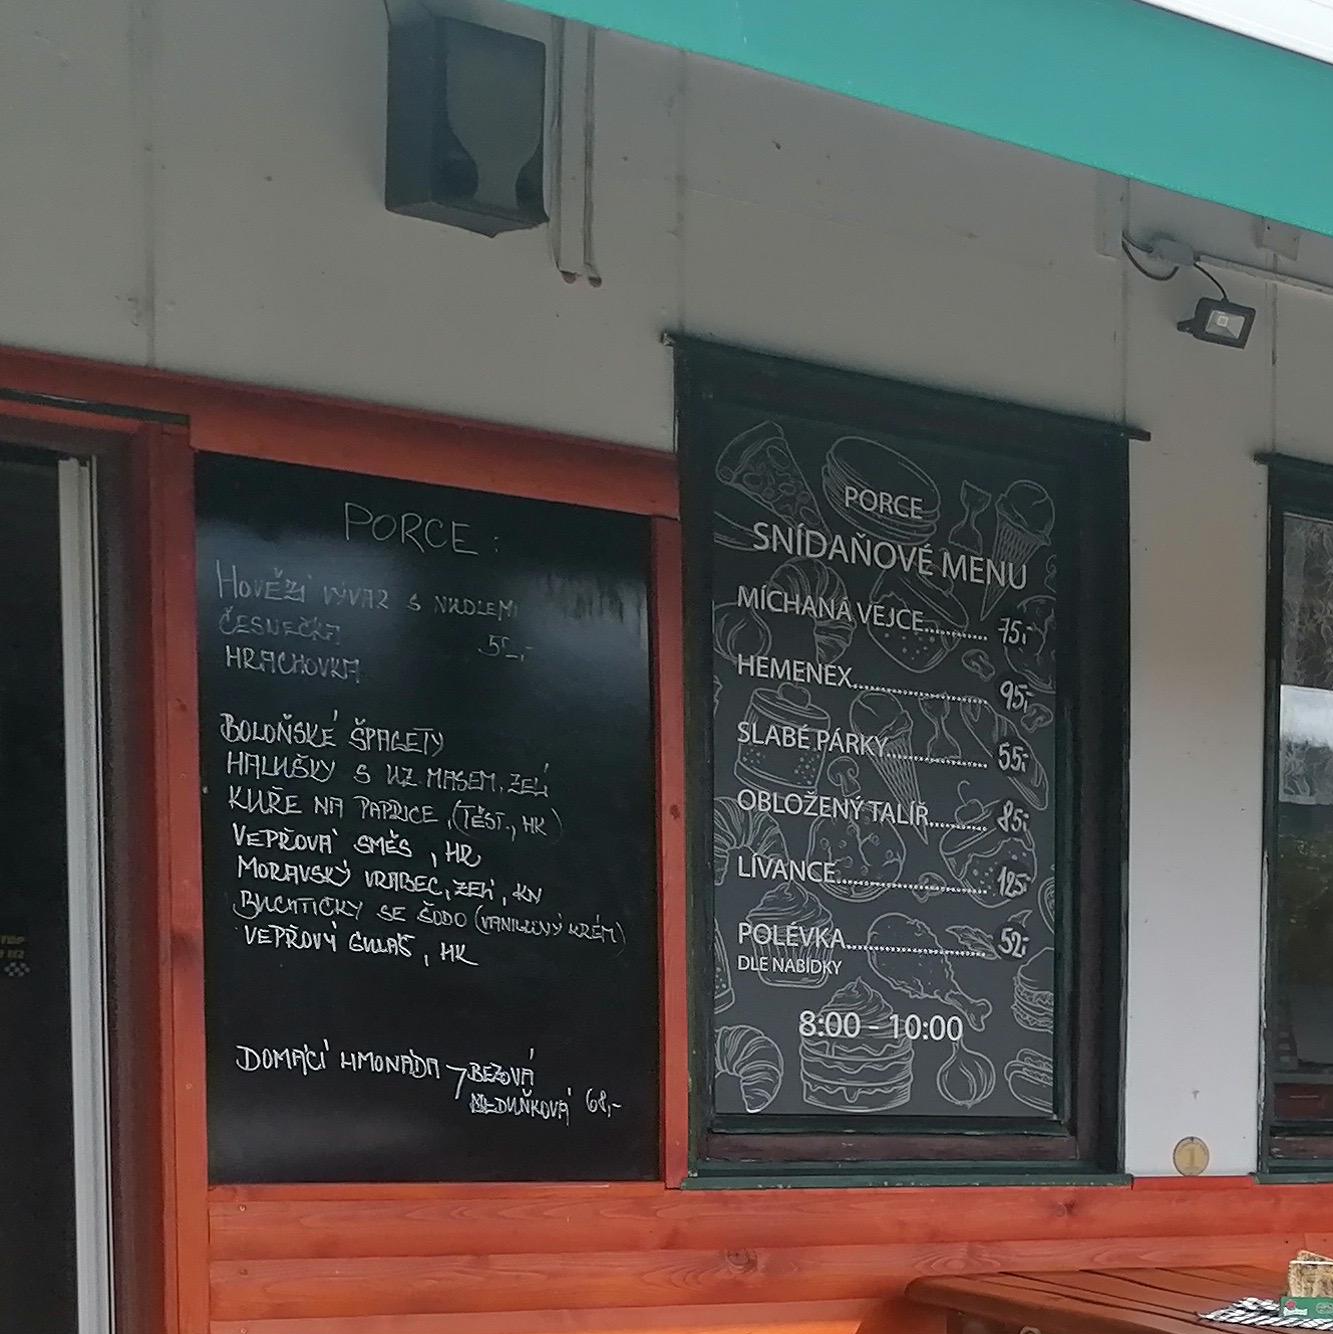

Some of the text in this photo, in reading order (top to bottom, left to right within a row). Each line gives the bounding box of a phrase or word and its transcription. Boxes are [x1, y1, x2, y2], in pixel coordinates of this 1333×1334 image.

[844, 486, 924, 520] PORCE
[752, 521, 1028, 591] SNÍDAŇOVÉ MENU
[407, 593, 422, 612] S
[736, 584, 853, 622] MÍCHANÁ
[856, 604, 924, 632] VEJCE
[736, 653, 853, 687] HEMENEX
[220, 709, 444, 758] BOLOŇSKÉ ŠPAGETY
[736, 718, 811, 750] SLABÉ
[816, 724, 889, 758] PÁRKY
[227, 751, 336, 783] HALUŠKY
[353, 763, 371, 784] S
[228, 785, 303, 816] KUŘE
[314, 796, 344, 819] NA
[736, 788, 865, 821] OBLOŽENÝ
[869, 798, 929, 827] TALÍŘ
[231, 822, 340, 855] VEPŘOVÁ
[237, 855, 352, 887] MORAVSKÝ
[737, 852, 836, 883] LÍVANCE
[375, 904, 406, 922] SE
[244, 920, 338, 953] VEPŘOVÝ
[737, 920, 846, 948] POLÉVKA
[737, 955, 842, 975] DLE NABÍDKY
[798, 1010, 862, 1039] 8:00
[889, 1013, 964, 1042] 10:00
[235, 1038, 330, 1076] DOMÁCÍ
